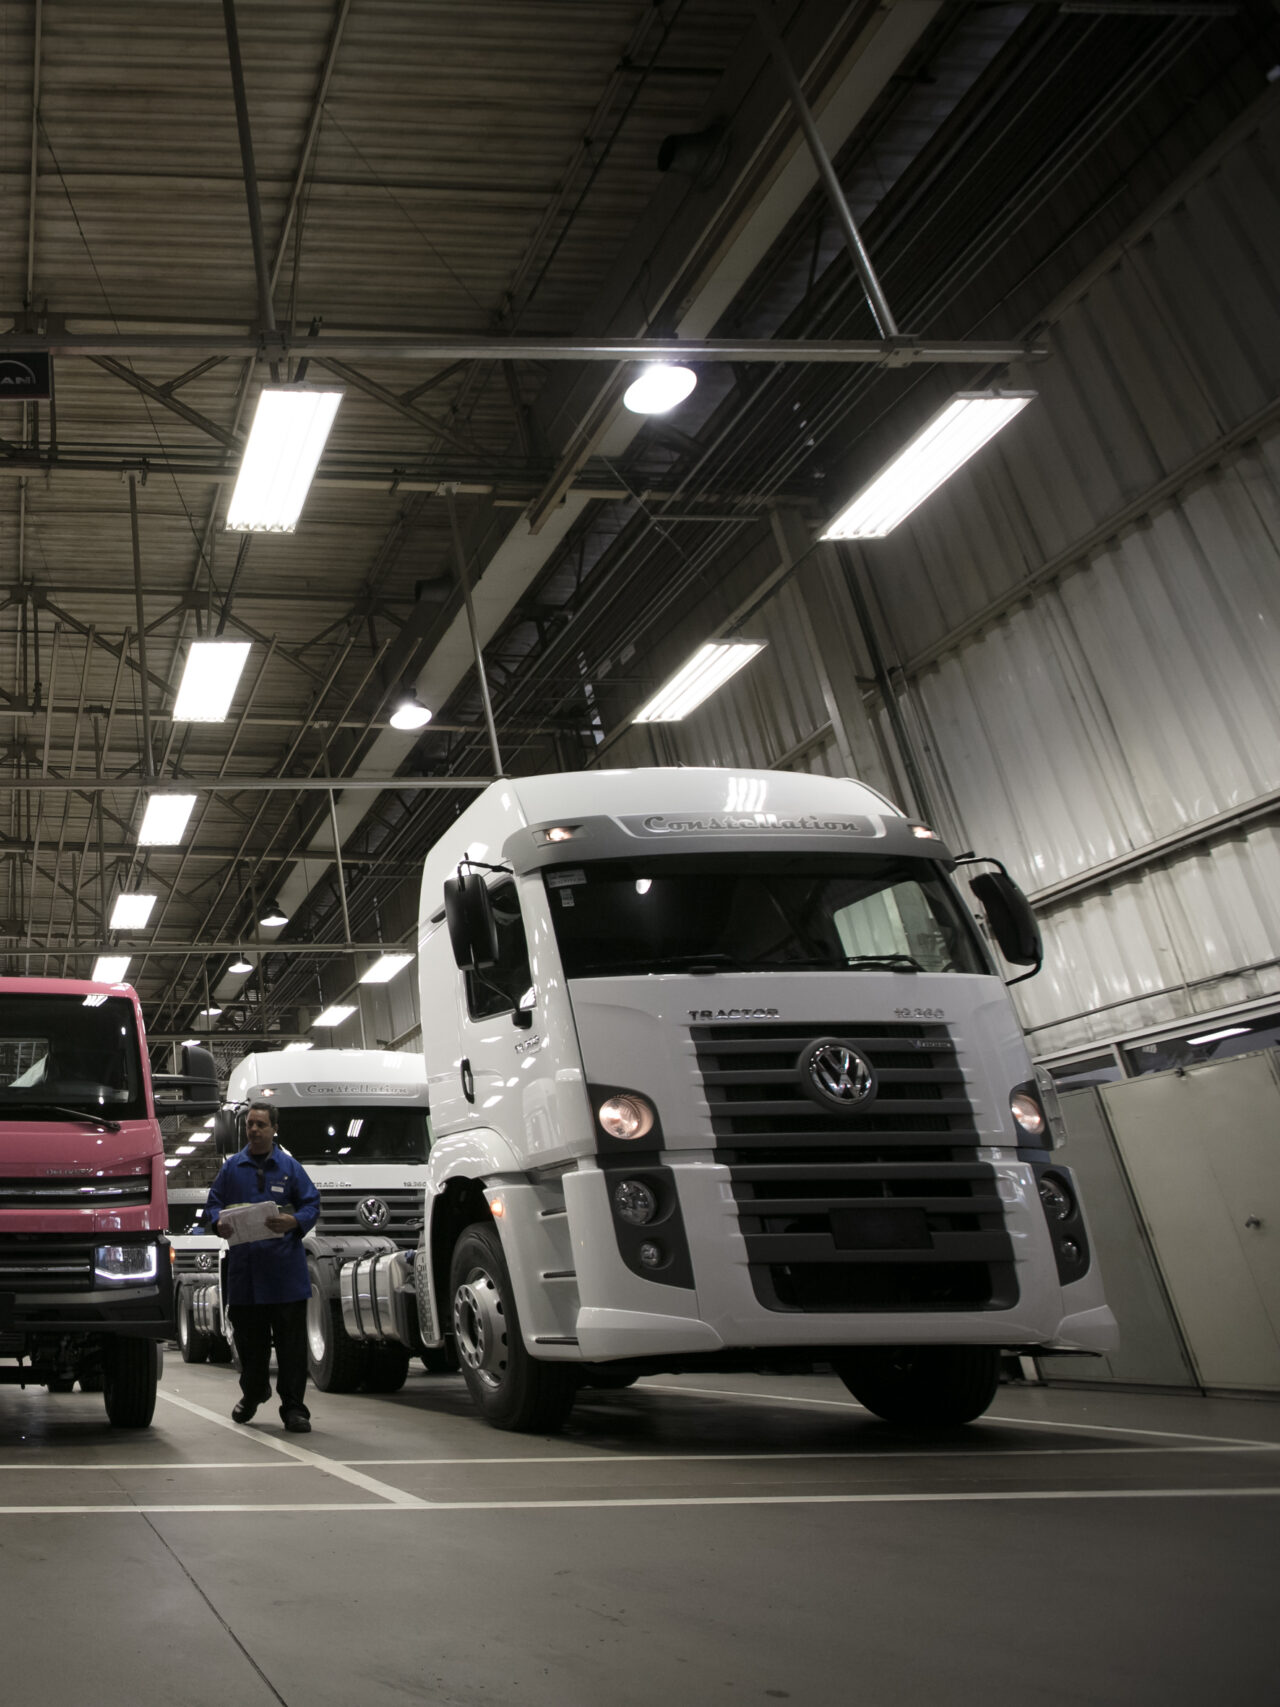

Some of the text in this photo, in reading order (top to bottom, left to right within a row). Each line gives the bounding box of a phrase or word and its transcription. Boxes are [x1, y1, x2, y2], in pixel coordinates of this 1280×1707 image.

[643, 815, 860, 833] Constellation
[687, 1008, 781, 1021] TRACTOR
[306, 1084, 408, 1094] Constellation
